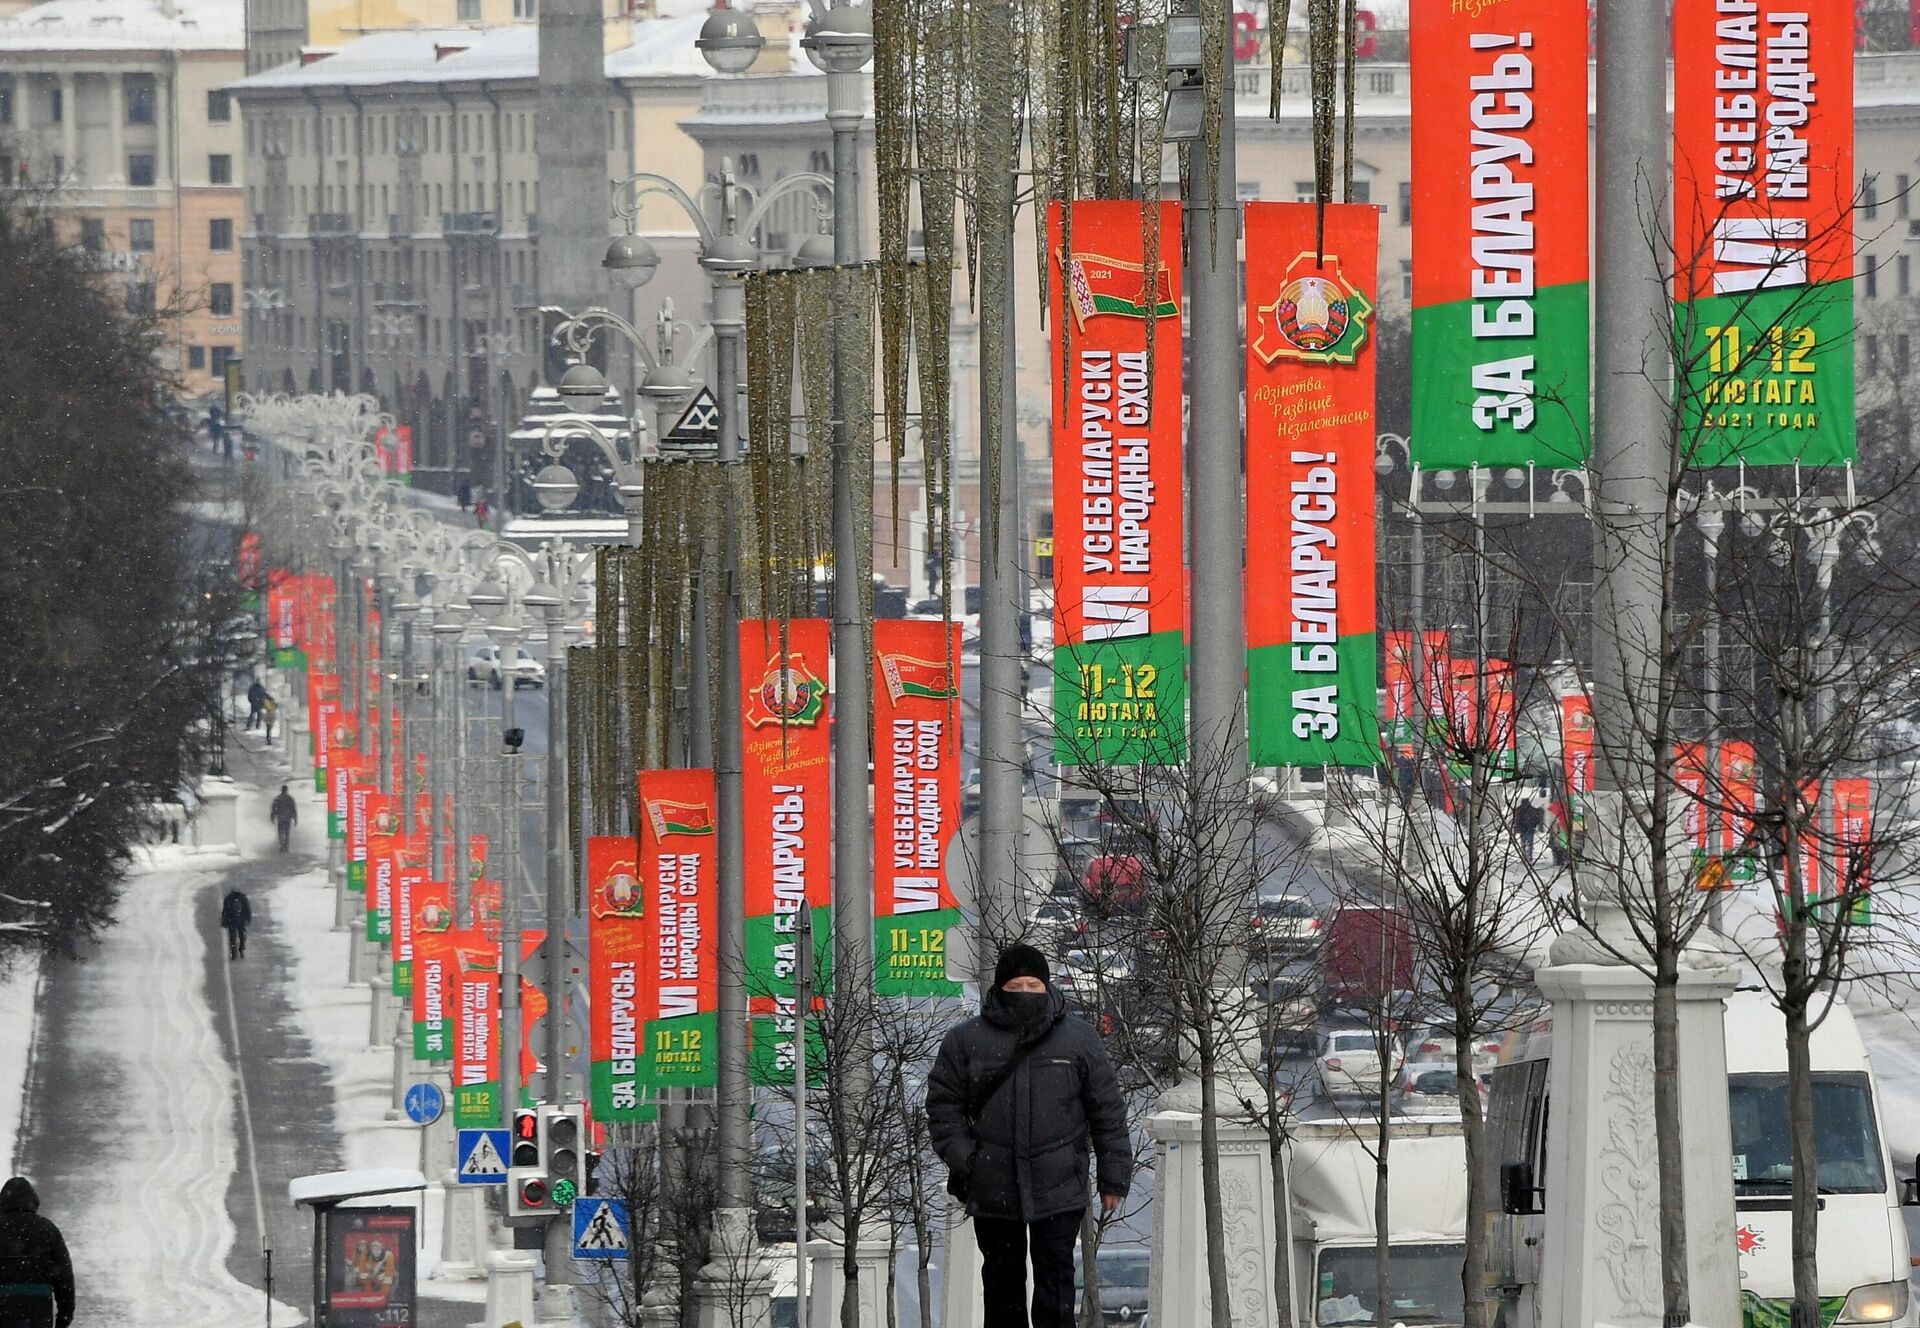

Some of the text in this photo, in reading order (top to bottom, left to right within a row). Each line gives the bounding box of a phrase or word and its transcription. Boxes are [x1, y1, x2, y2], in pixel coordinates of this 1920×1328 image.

[1766, 13, 1815, 197] НАРОДНЫ
[1470, 33, 1533, 336] БЕЛАРУСЬ!
[1090, 270, 1112, 279] 2021
[1714, 219, 1806, 293] VI
[1705, 326, 1816, 372] 11-12
[1254, 377, 1326, 405] Адзінства.
[1274, 394, 1336, 421] Развіццё.
[1472, 355, 1533, 429] ЗА
[1706, 380, 1814, 403] ЛЮТАГА
[1277, 409, 1374, 440] Незалежнасць.
[1704, 413, 1816, 429] 2021 ГОДА
[1082, 351, 1112, 571] УСЕБЕЛАРУСКІ
[1118, 351, 1153, 571] НАРОДНЫ СХОД
[1083, 587, 1148, 640] VI
[1291, 452, 1337, 739] ЗА БЕЛАРУСЬ!
[1078, 665, 1156, 698] 11-12
[1079, 703, 1155, 720] ЛЮТАГА
[894, 720, 913, 867] УСЕБЕЛАРУСКІ
[918, 720, 942, 867] НАРОДНЫ СХОД
[773, 785, 807, 932] БЕЛАРУСЬ!
[894, 877, 938, 913] VI
[379, 920, 390, 934] ЗА
[659, 855, 676, 979] УСЕБЕЛАРУСКІ
[680, 854, 700, 978] НАРОДНЫ СХОД
[891, 955, 942, 966] ЛЮТАГА
[892, 929, 943, 951] 11-12
[426, 960, 442, 1050] ЗА БЕЛАРУСЬ!
[475, 982, 490, 1060] НАРОДНЫ СХОД
[612, 962, 635, 1074] БЕЛАРУСЬ!
[660, 986, 697, 1018] VI
[657, 1052, 699, 1062] ЛЮТАГА
[658, 1031, 700, 1049] 11-12
[463, 1065, 487, 1085] VI
[613, 1081, 635, 1108] ЗА
